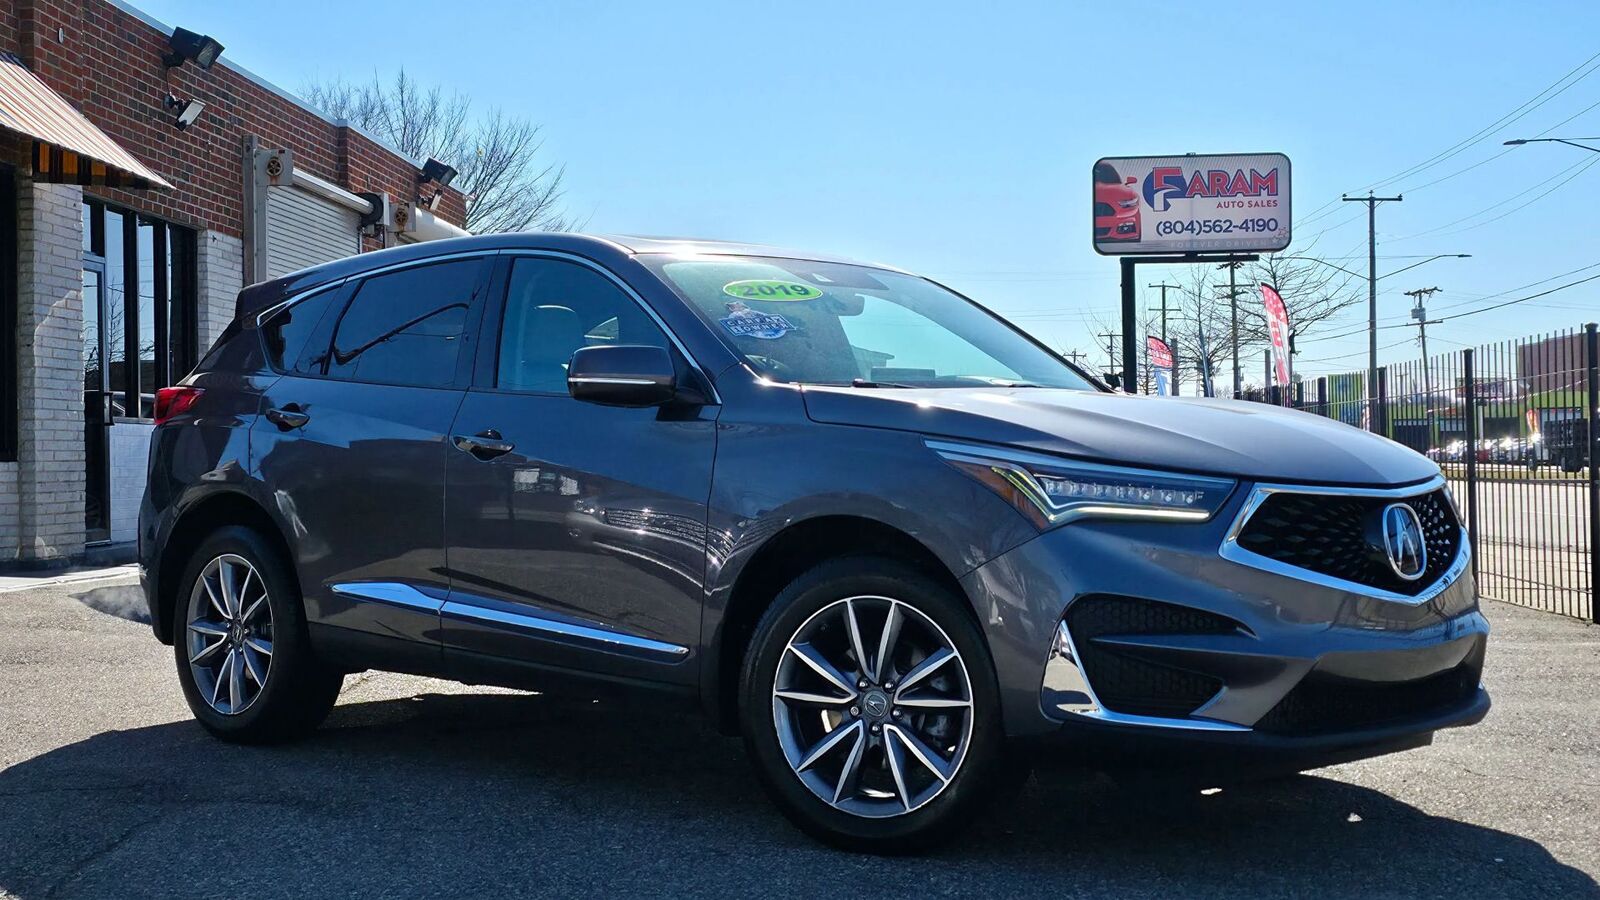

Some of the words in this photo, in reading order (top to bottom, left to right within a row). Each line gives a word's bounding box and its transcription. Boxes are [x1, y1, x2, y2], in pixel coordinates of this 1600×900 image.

[1146, 167, 1278, 211] FARAM
[1216, 200, 1244, 209] AUTO
[1247, 200, 1278, 208] SALES
[1156, 218, 1279, 237] (804)562-4190
[741, 285, 810, 296] 2019
